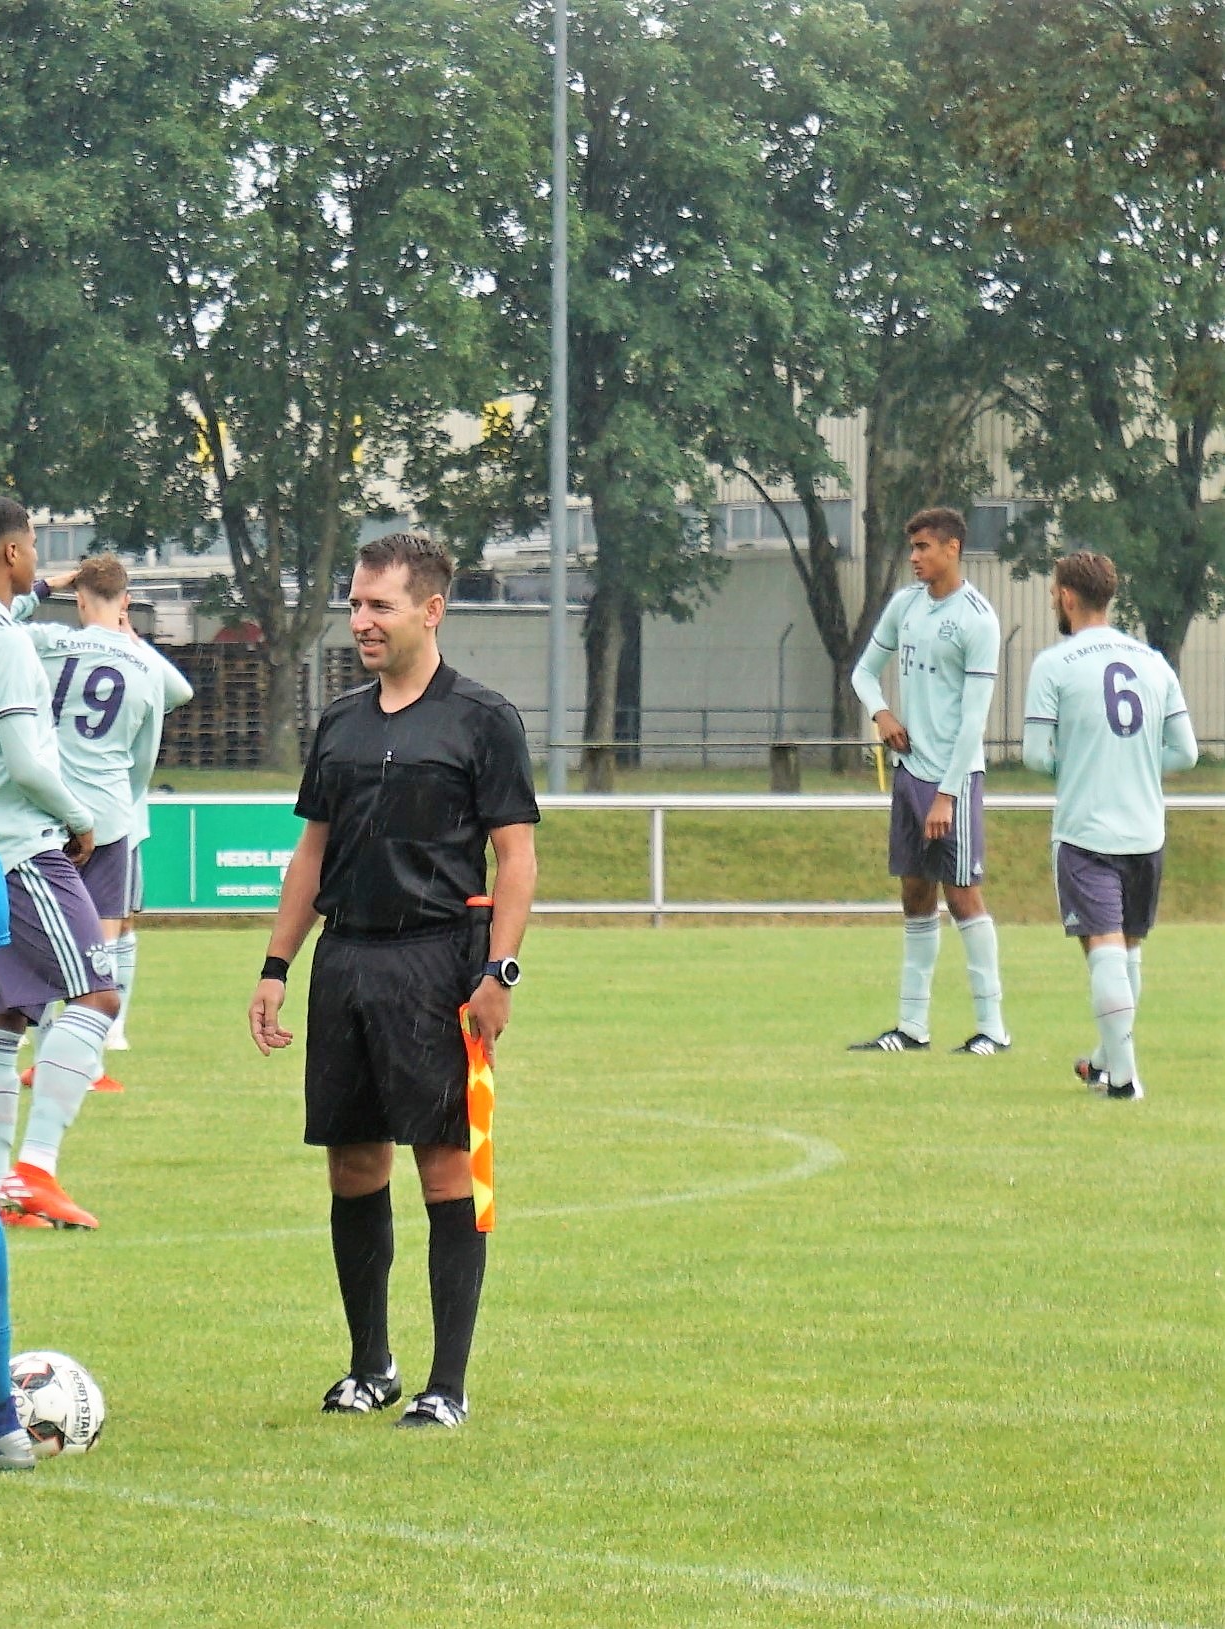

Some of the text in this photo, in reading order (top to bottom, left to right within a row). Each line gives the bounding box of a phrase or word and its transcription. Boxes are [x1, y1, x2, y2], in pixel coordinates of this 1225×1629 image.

[69, 640, 106, 652] BAYERN
[1063, 652, 1077, 664] FC
[1076, 642, 1113, 658] BAYERN
[52, 657, 126, 741] 19
[1103, 661, 1144, 739] 6
[216, 850, 294, 868] HEIDELBE
